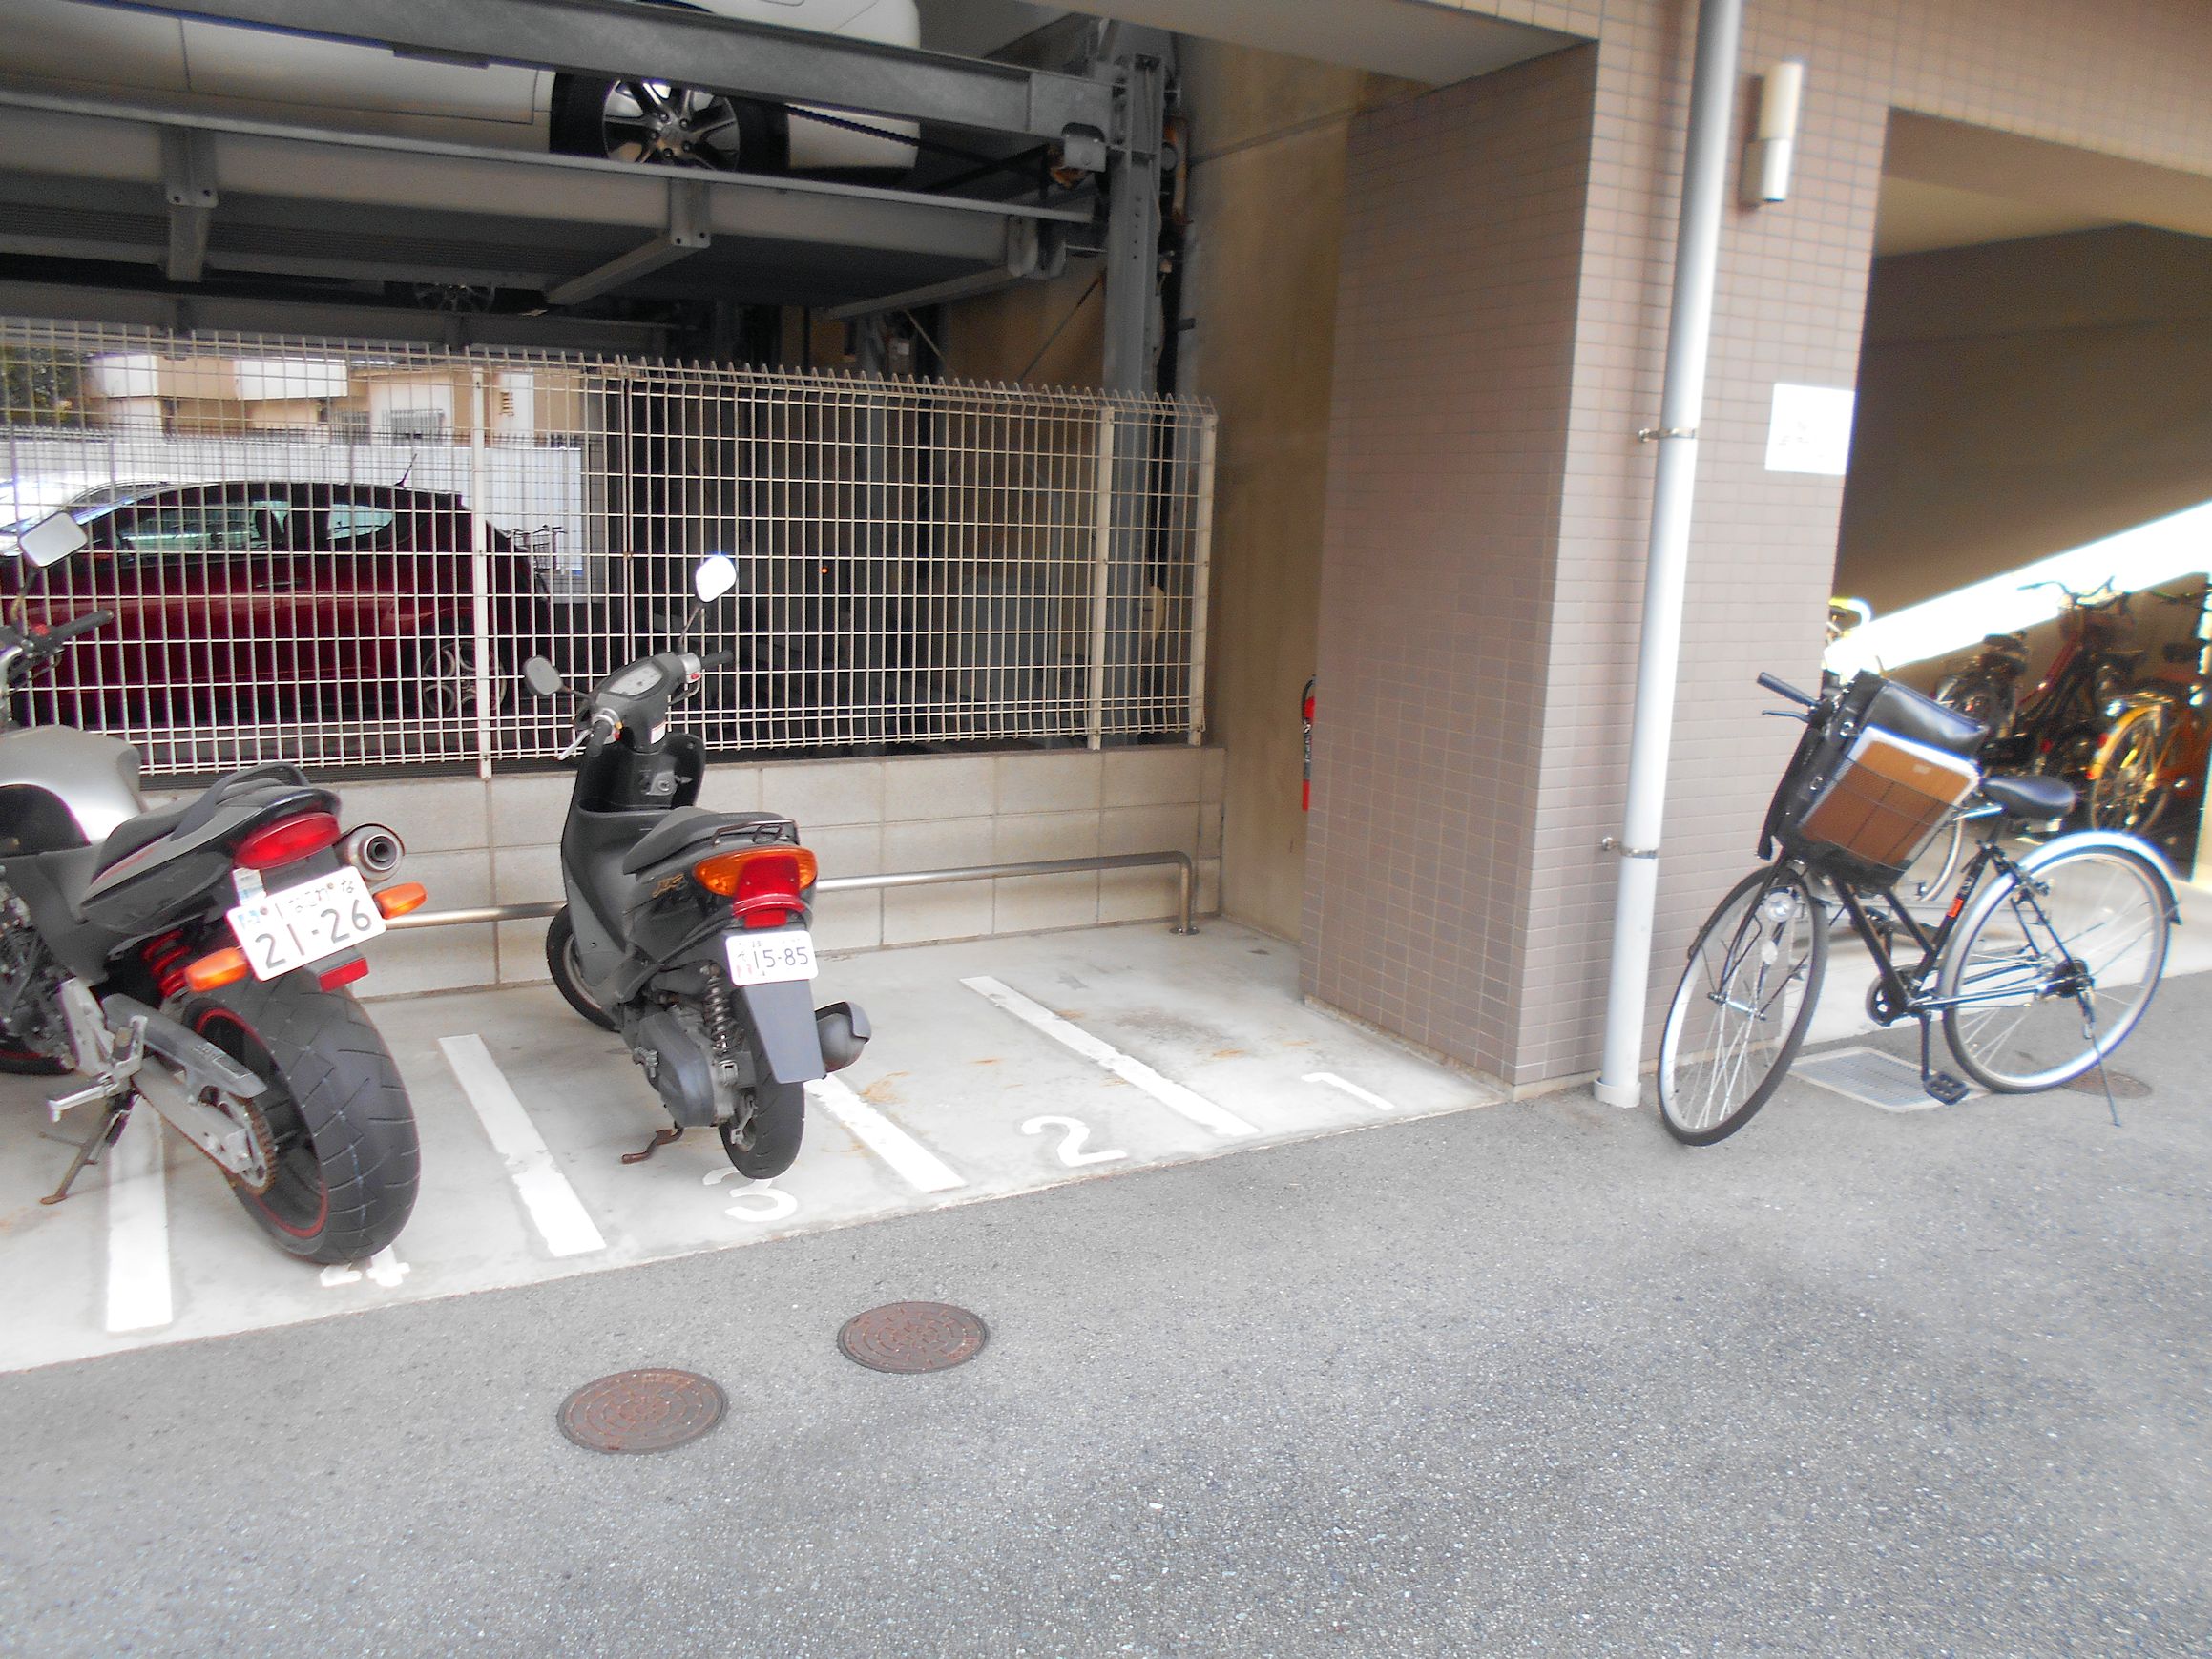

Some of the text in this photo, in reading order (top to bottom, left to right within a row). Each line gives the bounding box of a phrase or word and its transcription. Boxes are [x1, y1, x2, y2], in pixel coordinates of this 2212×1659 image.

[254, 898, 372, 970] 21-26
[753, 946, 809, 970] 15-85
[1021, 1115, 1127, 1167] 2
[702, 1166, 798, 1222] 3
